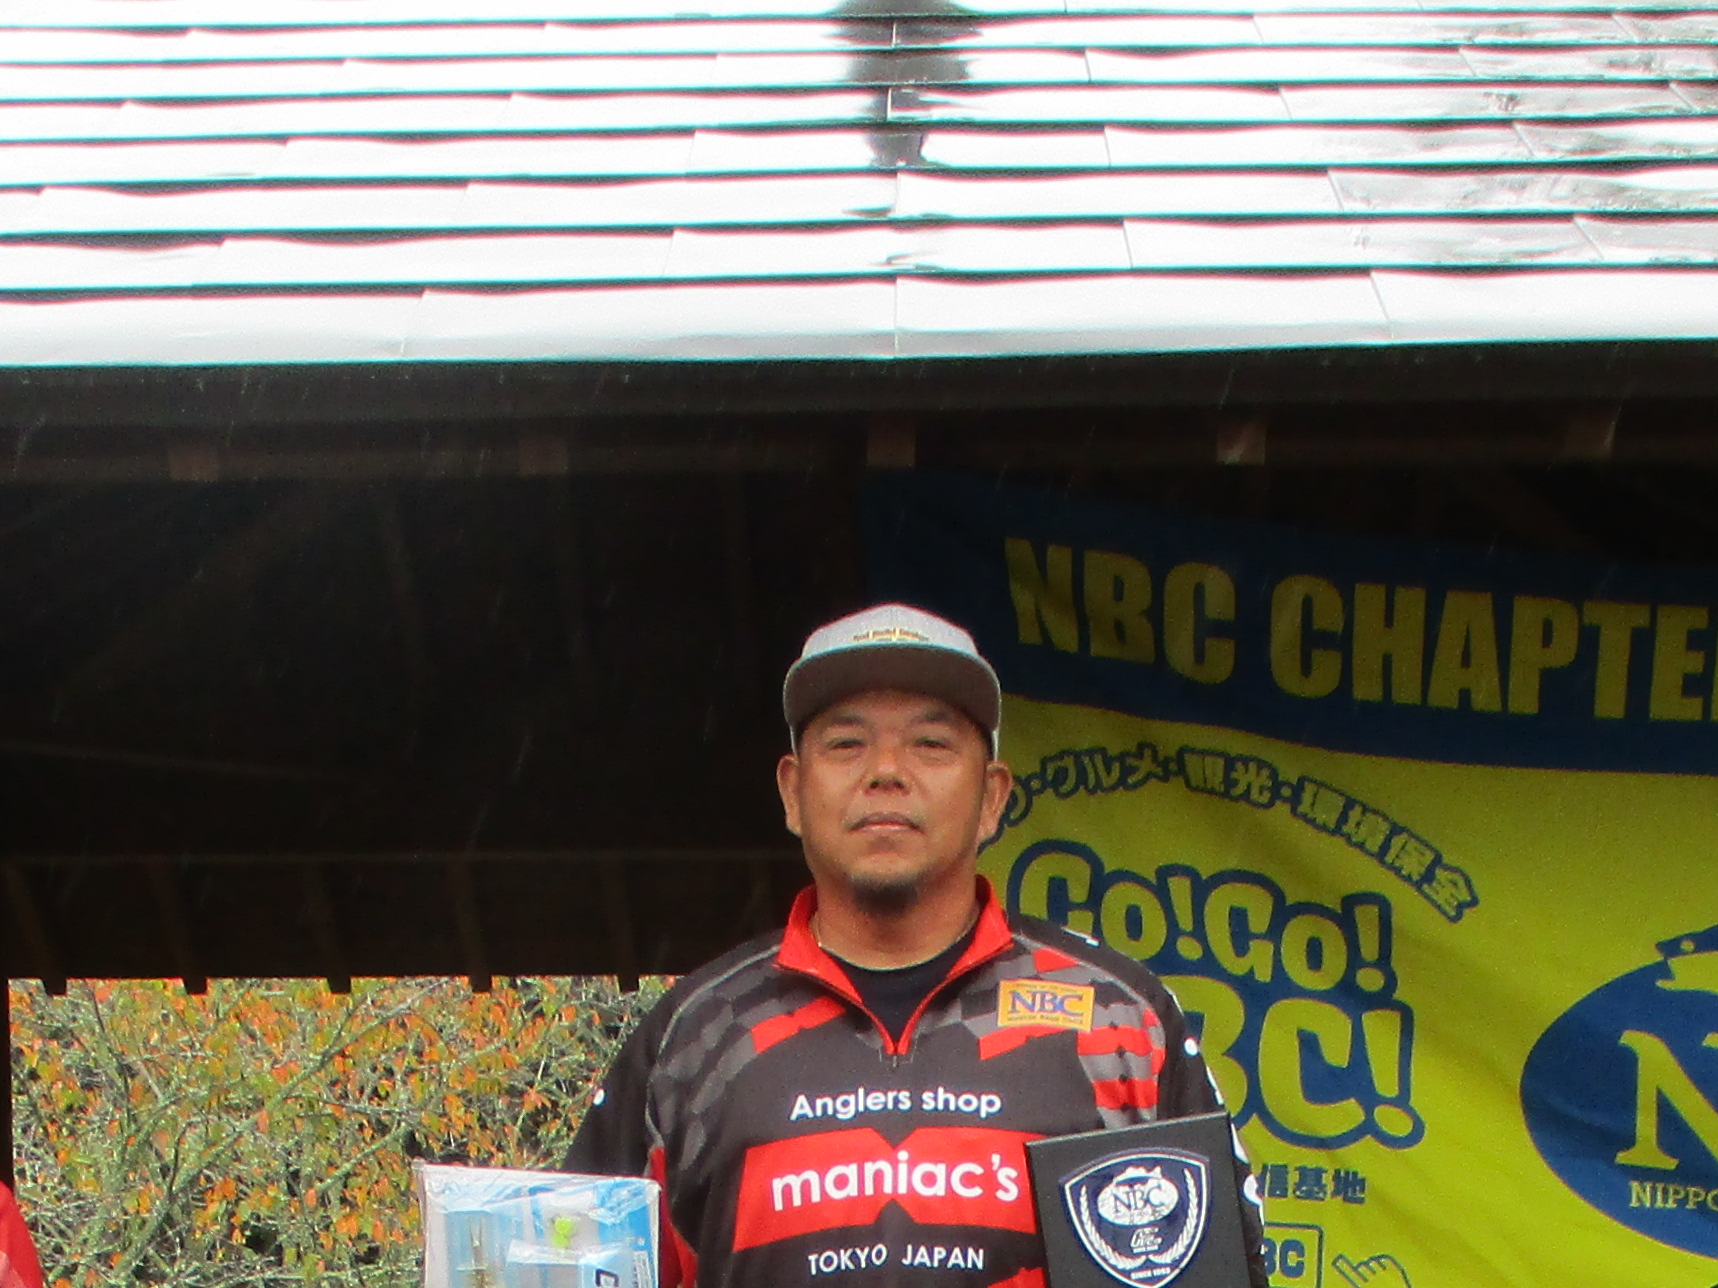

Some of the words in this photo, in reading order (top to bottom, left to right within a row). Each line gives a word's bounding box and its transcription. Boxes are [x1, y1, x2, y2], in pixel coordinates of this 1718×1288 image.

[1005, 538, 1238, 687] NBC
[1009, 991, 1084, 1016] NBC
[790, 1087, 911, 1121] Anglers
[921, 1087, 1002, 1118] shop
[772, 1151, 1020, 1211] maniac's
[1113, 1181, 1167, 1214] NBC
[807, 1244, 887, 1276] TOKYO
[901, 1244, 984, 1271] JAPAN
